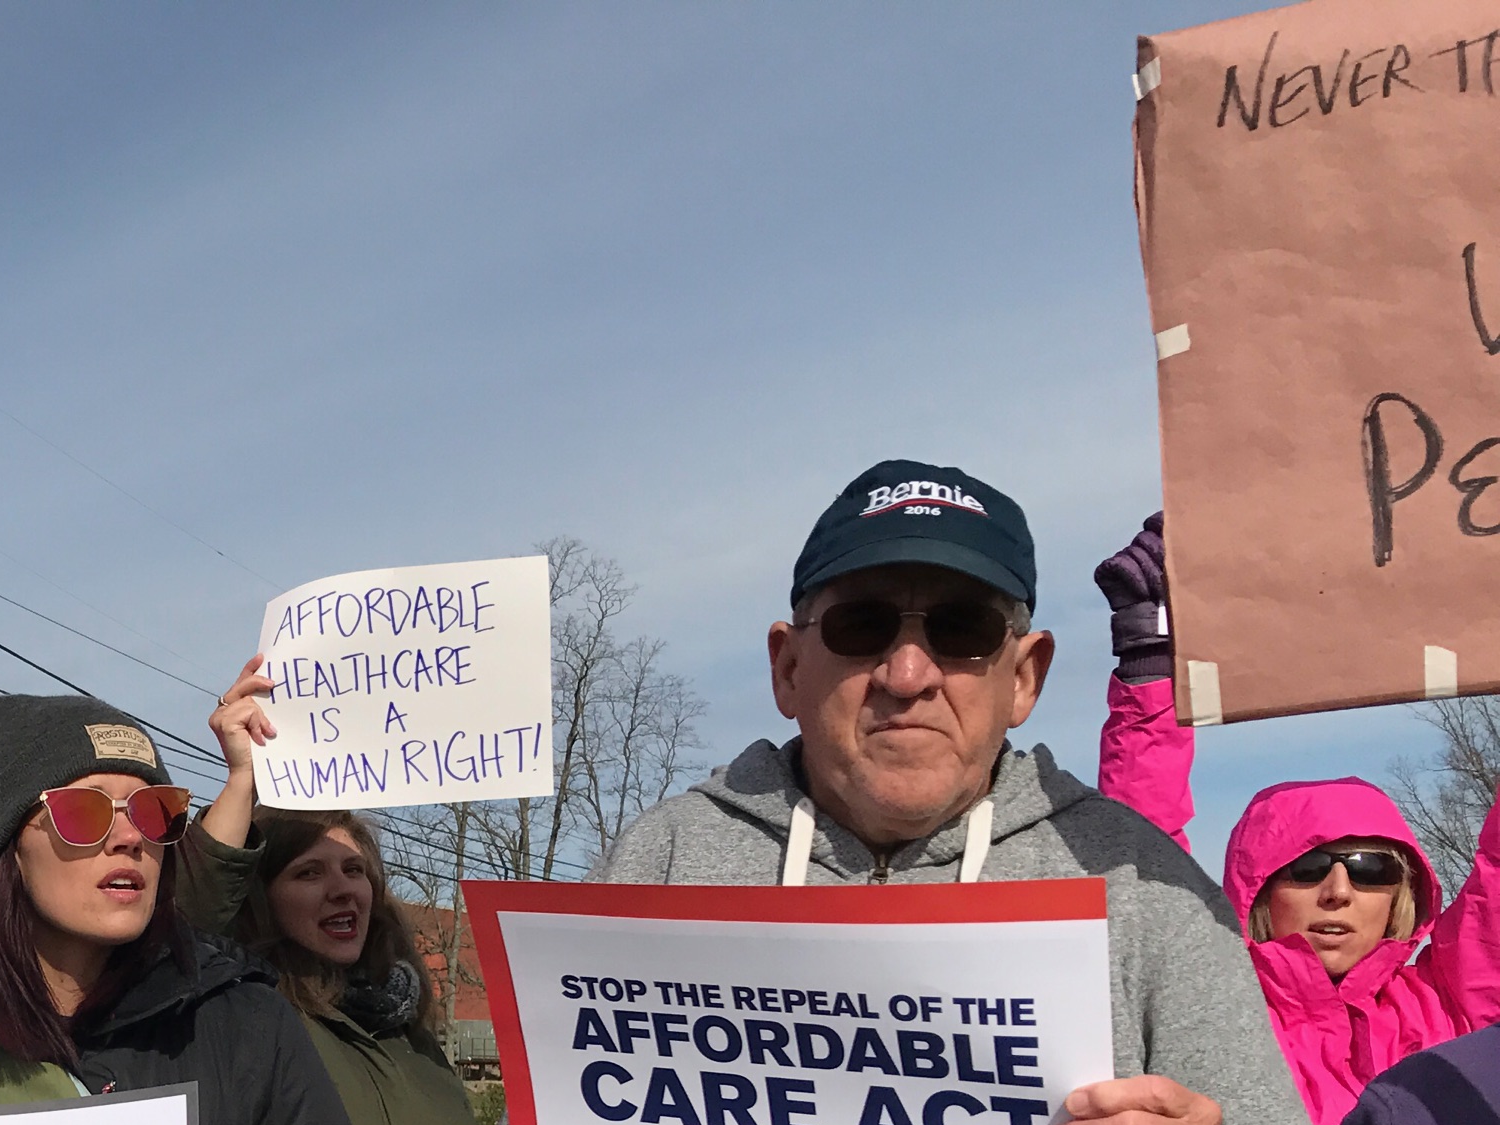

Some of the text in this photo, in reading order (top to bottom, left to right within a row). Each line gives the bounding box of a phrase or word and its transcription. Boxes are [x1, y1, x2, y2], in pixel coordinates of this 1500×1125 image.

[1217, 30, 1425, 132] NEVER
[868, 480, 984, 510] Bernie
[904, 506, 941, 516] 2016
[273, 580, 495, 646] AFFORDABLE
[267, 645, 477, 704] HEALTHCARE
[310, 701, 407, 743] IS A
[266, 722, 542, 799] HUMAN RIGHT!
[560, 974, 1037, 1026] STOP THE REPEAL OF THE
[572, 1006, 1045, 1088] AFFORDABLE
